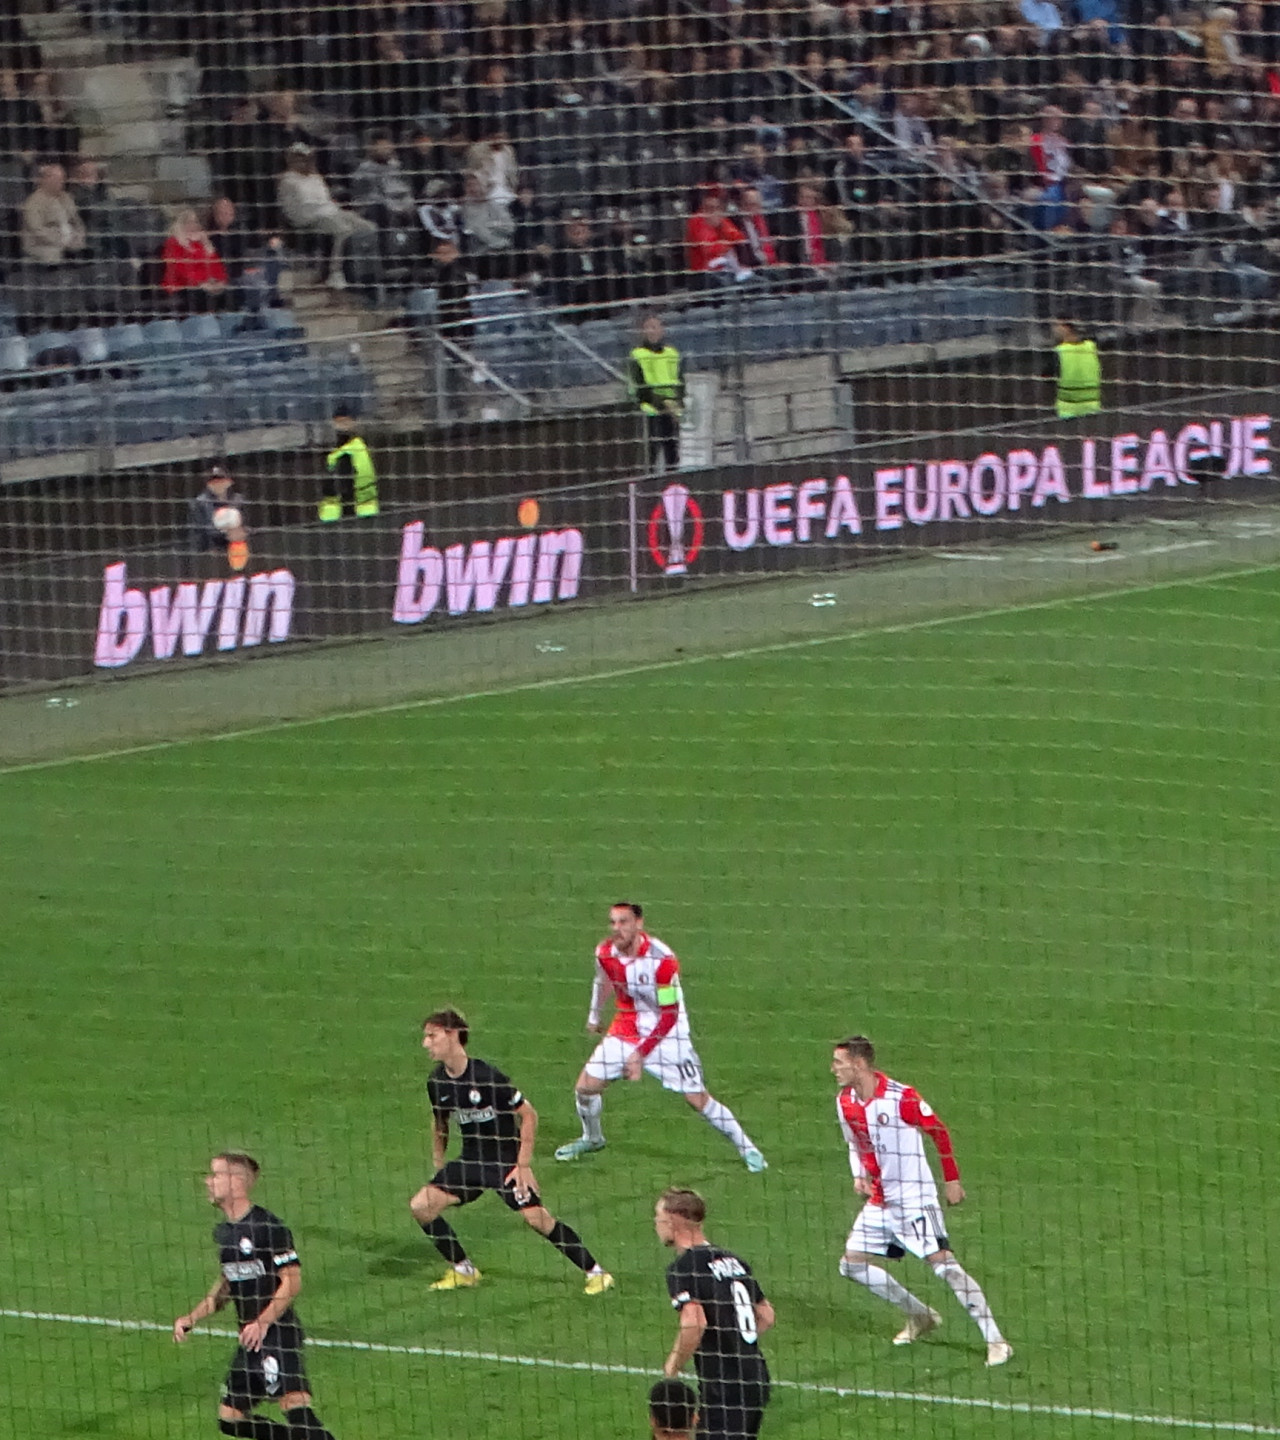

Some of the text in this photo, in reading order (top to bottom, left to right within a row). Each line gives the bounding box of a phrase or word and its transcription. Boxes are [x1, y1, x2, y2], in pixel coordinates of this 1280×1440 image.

[722, 414, 1273, 551] UEFA EUROPA LEAGUE
[93, 540, 296, 668] bwin
[392, 498, 584, 624] bwin
[911, 1216, 927, 1241] 17
[730, 1279, 758, 1345] 8
